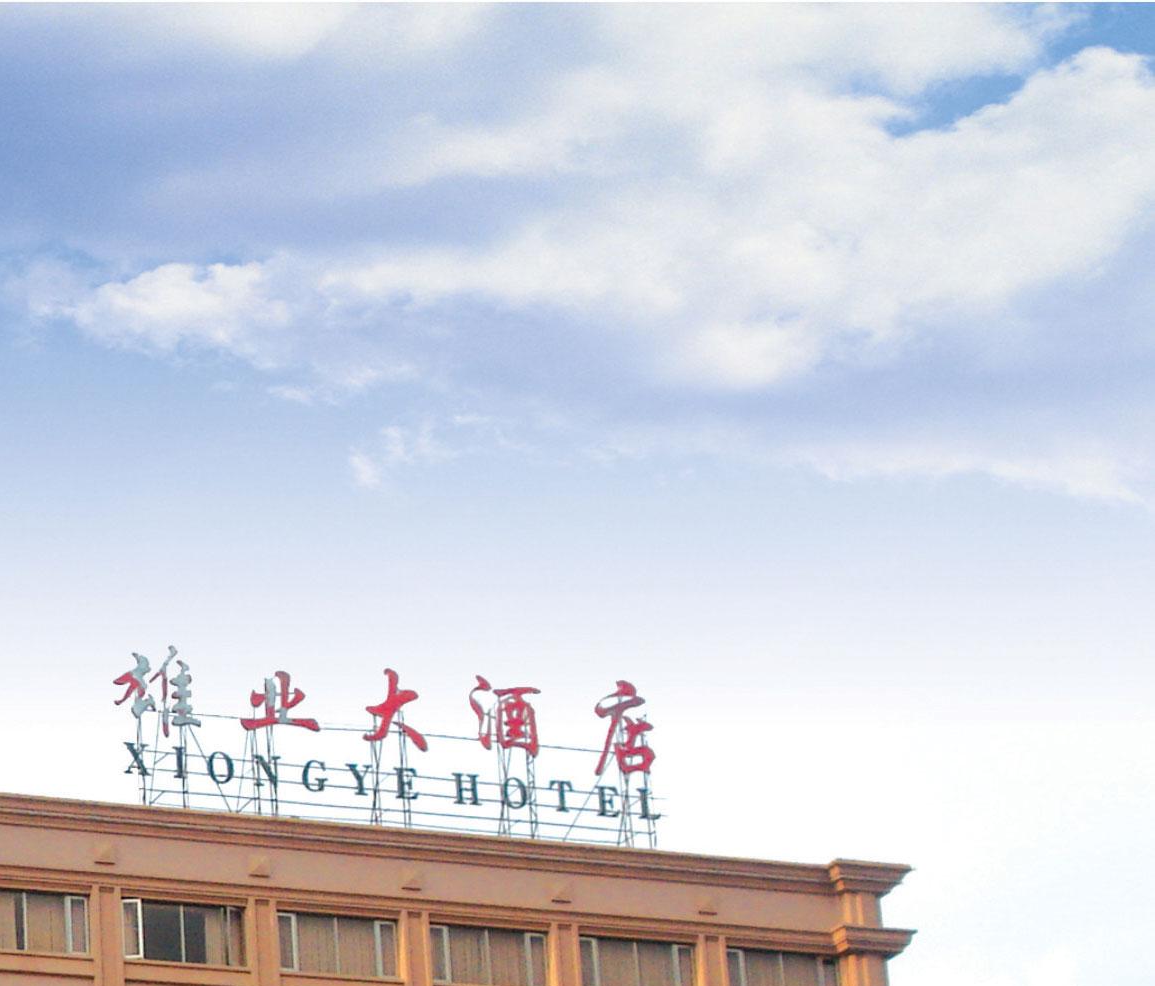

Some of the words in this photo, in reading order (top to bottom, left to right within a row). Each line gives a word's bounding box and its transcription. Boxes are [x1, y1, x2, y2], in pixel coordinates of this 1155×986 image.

[113, 645, 656, 775] 雄业大酒店
[124, 742, 419, 799] XIONGYE
[452, 772, 661, 820] HOTEL
